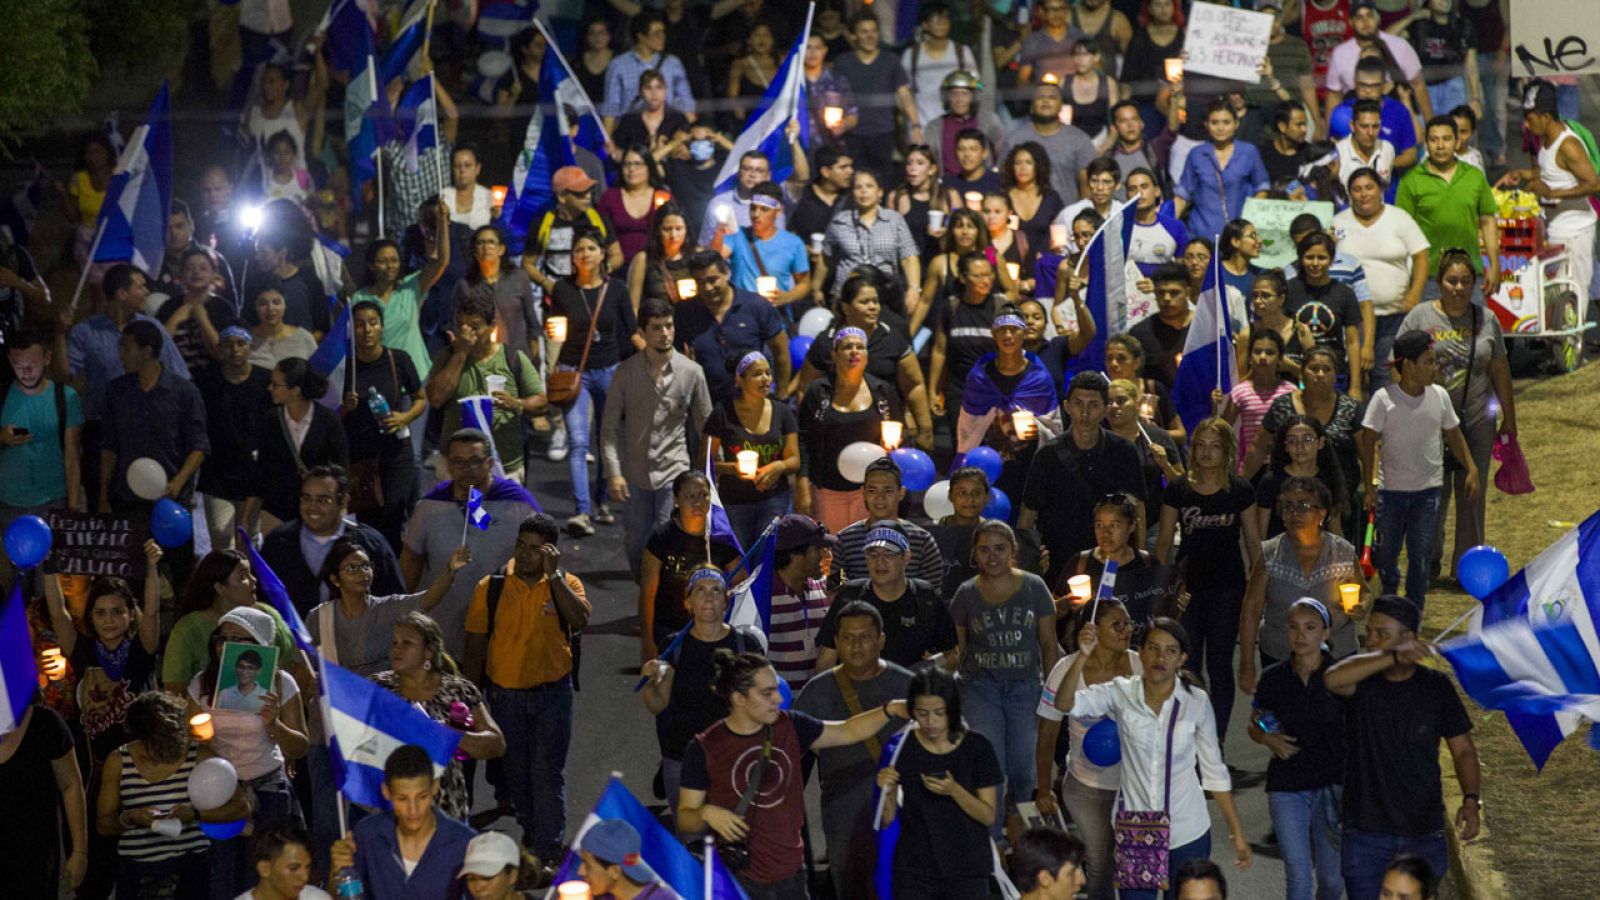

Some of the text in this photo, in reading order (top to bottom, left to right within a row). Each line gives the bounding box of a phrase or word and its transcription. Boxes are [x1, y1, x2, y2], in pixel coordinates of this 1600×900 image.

[1180, 505, 1235, 535] Guess
[969, 606, 1036, 634] NEVER
[986, 629, 1022, 647] STOP
